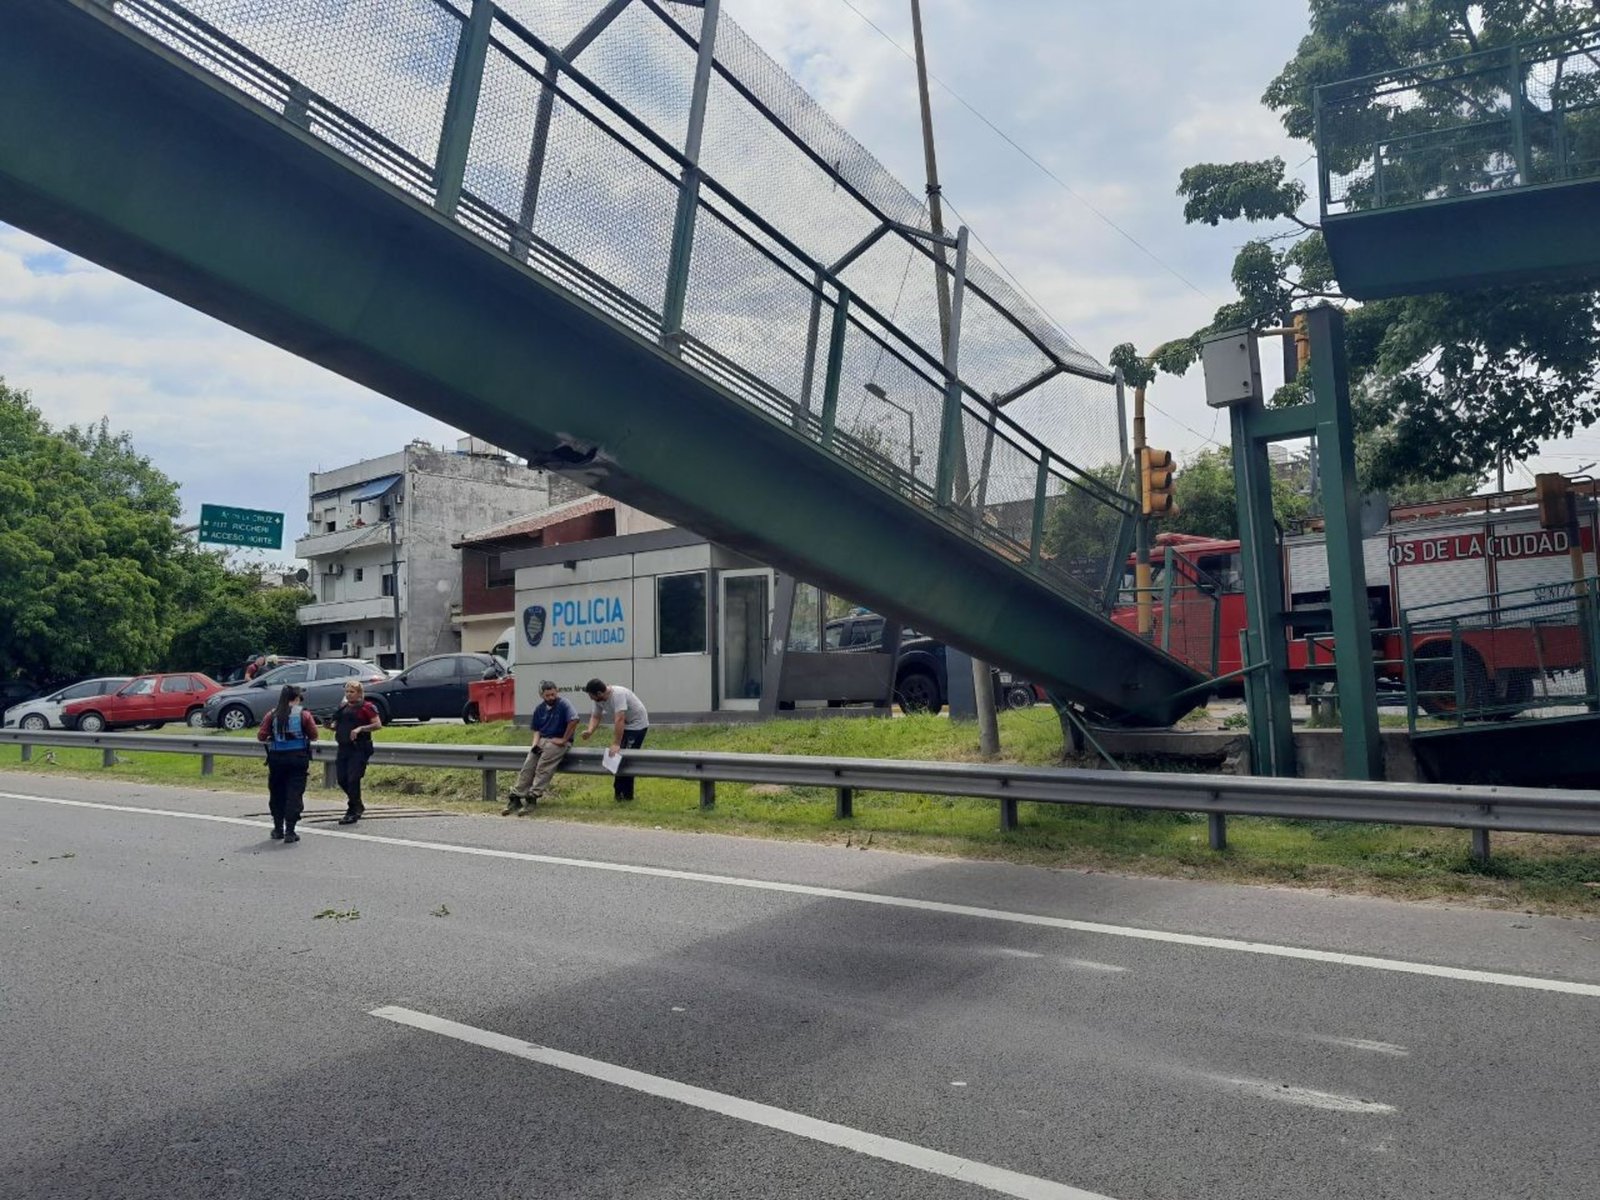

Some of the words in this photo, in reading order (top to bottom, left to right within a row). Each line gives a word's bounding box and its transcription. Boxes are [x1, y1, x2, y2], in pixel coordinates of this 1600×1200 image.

[253, 514, 273, 523] CRUZ
[232, 523, 269, 533] RICCHERI
[211, 531, 244, 541] ACCESO
[1423, 540, 1449, 561] DE
[1455, 536, 1482, 557] LA
[1487, 531, 1569, 557] CIUDAD
[552, 597, 624, 626] POLICIA
[552, 631, 566, 647] DE
[569, 631, 581, 646] LA
[585, 627, 625, 645] CIUDAD
